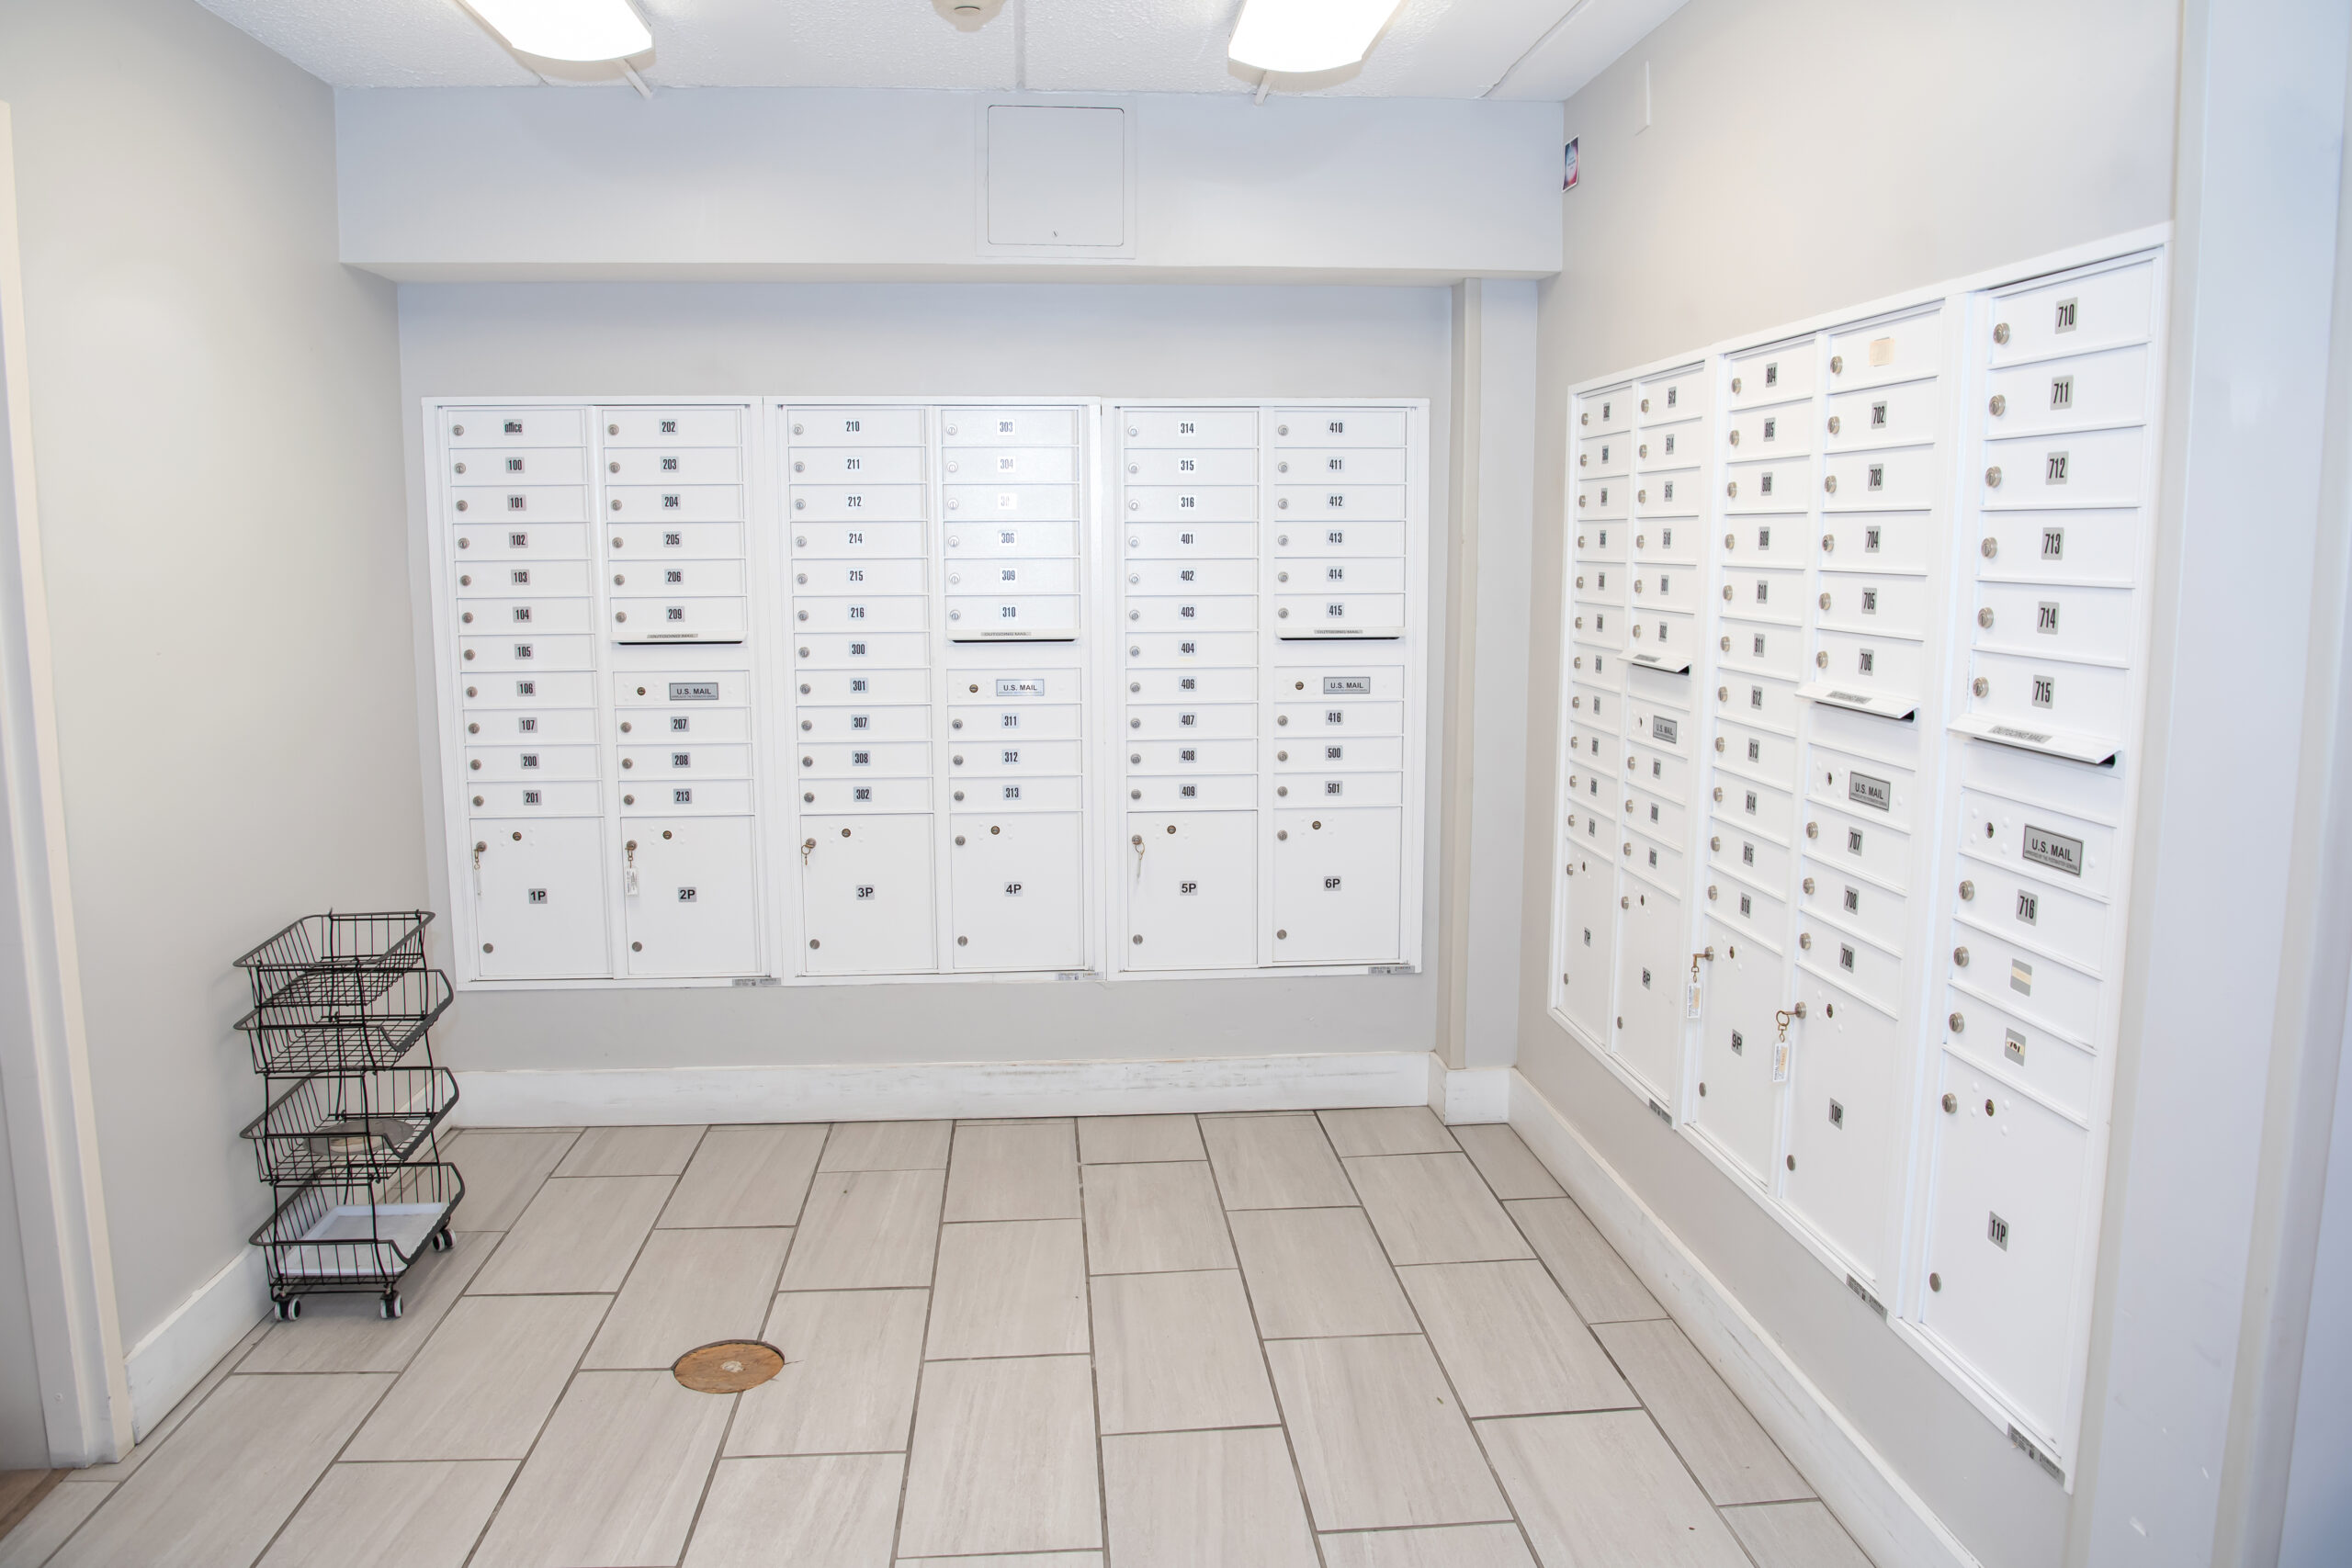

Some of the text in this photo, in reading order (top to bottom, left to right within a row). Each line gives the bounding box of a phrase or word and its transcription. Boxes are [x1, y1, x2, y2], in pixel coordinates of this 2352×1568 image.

[2058, 304, 2075, 328] 710
[2052, 382, 2069, 404] 711
[1872, 406, 1885, 424] 702
[504, 422, 523, 434] office
[662, 421, 676, 433] 202
[845, 421, 860, 433] 210
[999, 421, 1013, 433] 303
[1180, 423, 1194, 434] 314
[1329, 422, 1343, 434] 410
[508, 459, 523, 471] 100
[662, 458, 677, 470] 203
[847, 458, 860, 469] 211
[1000, 458, 1013, 469] 304
[1181, 459, 1194, 471] 315
[1329, 458, 1342, 470] 411
[2049, 457, 2065, 479] 712
[1870, 468, 1882, 487] 703
[510, 497, 524, 509] 101
[664, 496, 679, 508] 204
[847, 495, 862, 507] 212
[1000, 495, 1014, 507] 30
[1181, 496, 1194, 508] 316
[1329, 495, 1343, 507] 412
[511, 534, 526, 546] 102
[665, 534, 680, 546] 205
[849, 533, 863, 544] 214
[1001, 532, 1015, 544] 306
[1181, 533, 1193, 545] 401
[1329, 532, 1342, 544] 413
[1867, 531, 1879, 548] 704
[2044, 534, 2062, 555] 713
[514, 571, 528, 583] 103
[667, 570, 682, 582] 206
[849, 570, 864, 581] 215
[1001, 570, 1016, 581] 309
[1180, 570, 1194, 581] 402
[1329, 569, 1343, 580] 414
[1863, 592, 1876, 610] 705
[515, 608, 530, 621] 104
[668, 608, 683, 620] 209
[850, 606, 865, 618] 216
[1002, 606, 1016, 618] 310
[1181, 606, 1194, 618] 403
[1329, 604, 1342, 616] 415
[2040, 608, 2056, 629] 714
[517, 646, 531, 658] 105
[851, 643, 865, 655] 300
[1181, 642, 1195, 654] 404
[1860, 653, 1872, 671] 706
[519, 682, 534, 694] 106
[853, 680, 865, 692] 301
[1181, 678, 1195, 690] 406
[2034, 681, 2052, 704] 715
[854, 716, 868, 728] 307
[1004, 715, 1017, 727] 311
[1181, 715, 1195, 726] 407
[1328, 712, 1341, 723] 416
[521, 719, 536, 731] 107
[673, 718, 687, 730] 207
[854, 752, 869, 764] 308
[1004, 751, 1018, 762] 312
[1181, 750, 1195, 761] 408
[1328, 747, 1341, 759] 500
[523, 755, 537, 767] 200
[674, 754, 689, 766] 208
[855, 788, 870, 800] 302
[1005, 786, 1020, 798] 313
[1182, 785, 1195, 797] 409
[1327, 783, 1340, 794] 501
[1855, 782, 1867, 795] U.S.
[1868, 785, 1884, 800] MAIL
[526, 792, 539, 804] 201
[675, 790, 690, 802] 213
[1849, 832, 1861, 851] 707
[2031, 838, 2048, 854] U.S.
[2051, 843, 2073, 862] MAIL
[1005, 884, 1022, 895] 4P
[1181, 883, 1197, 894] 5P
[1325, 878, 1340, 889] 6P
[530, 890, 547, 901] 1P
[679, 888, 695, 900] 2P
[857, 886, 874, 898] 3P
[1845, 891, 1858, 910] 708
[2018, 896, 2035, 919] 716
[1841, 948, 1853, 968] 709
[1642, 971, 1651, 986] 8P
[1732, 1032, 1743, 1050] 9P
[1831, 1103, 1842, 1123] 10P
[1991, 1220, 2007, 1243] 11P
